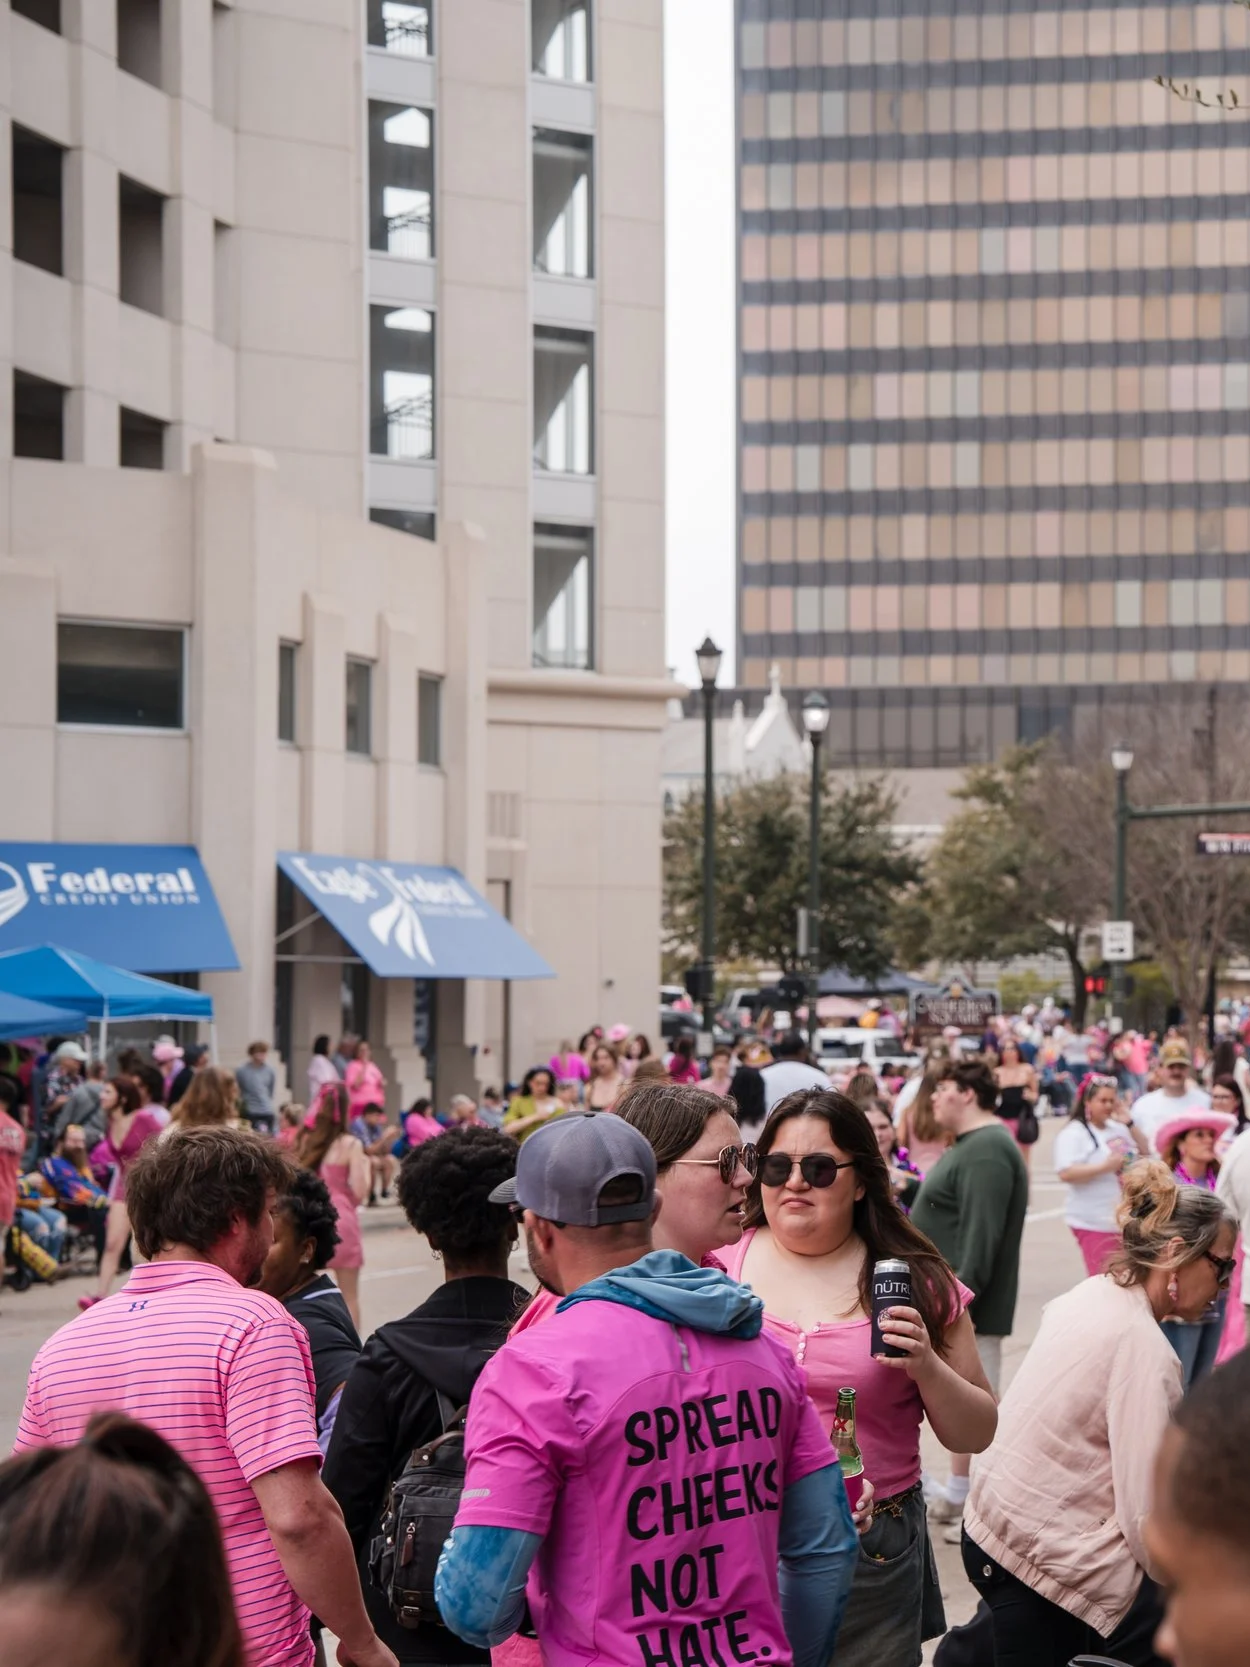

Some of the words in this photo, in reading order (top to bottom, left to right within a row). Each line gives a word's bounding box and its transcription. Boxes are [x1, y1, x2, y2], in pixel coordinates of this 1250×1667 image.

[27, 862, 196, 894] Federal
[625, 1387, 781, 1466] SPREAD
[627, 1459, 779, 1540] CHEEKS
[631, 1544, 724, 1617] NOT
[636, 1610, 772, 1667] HATE.
